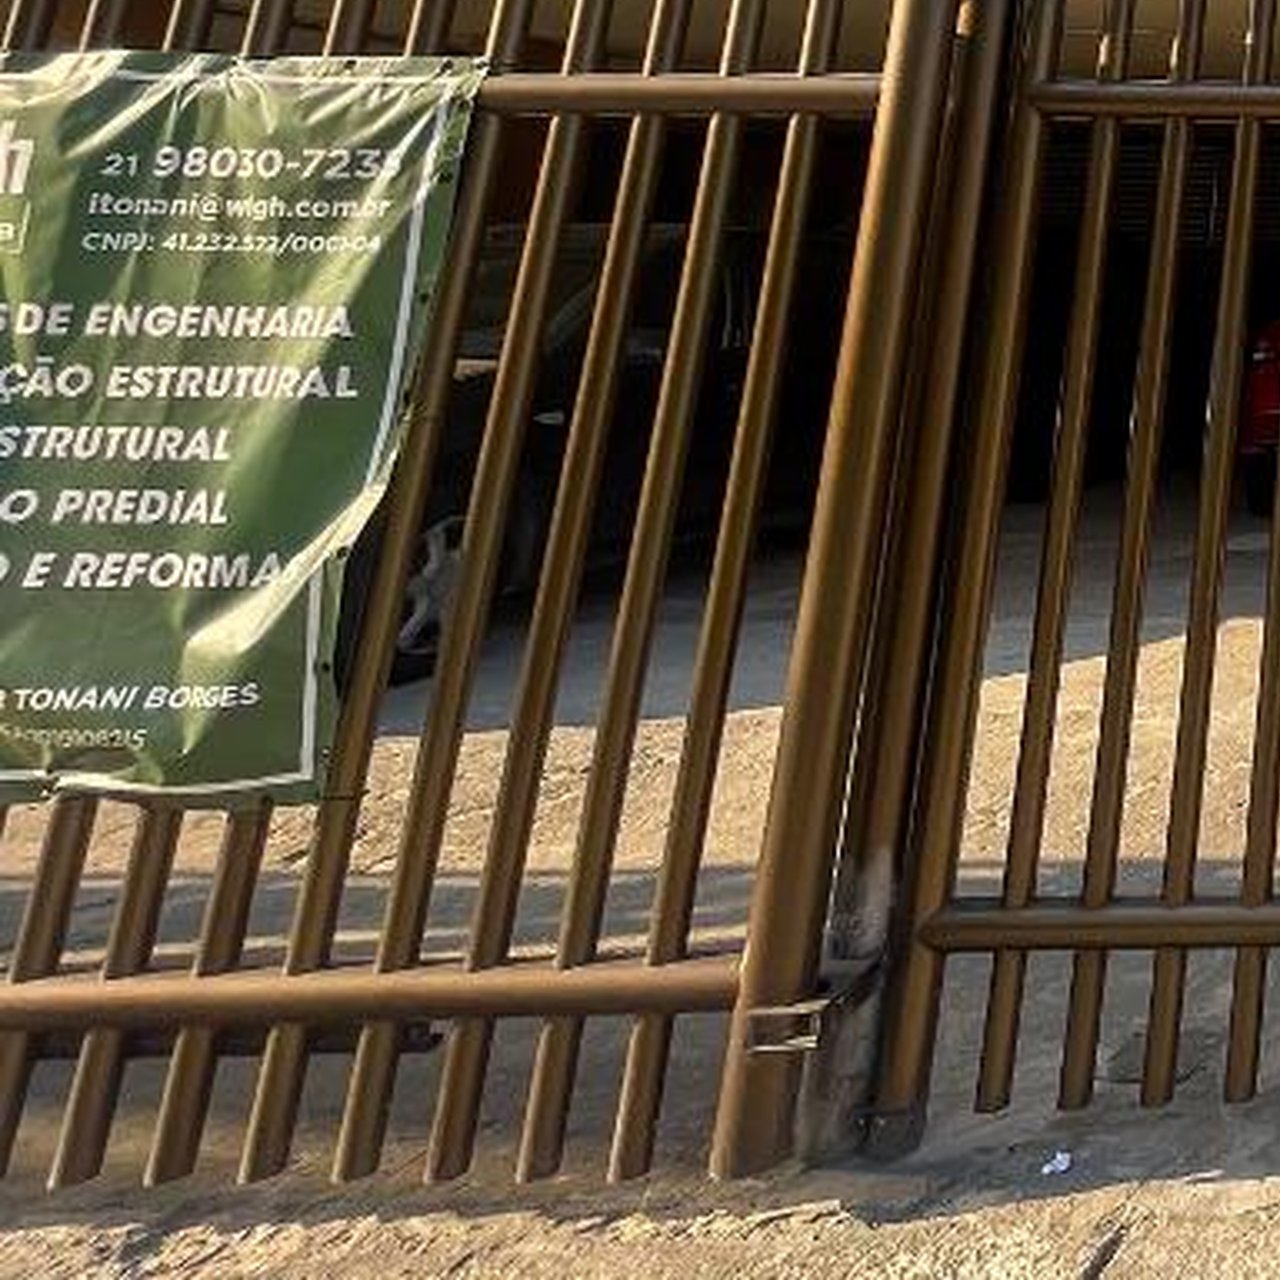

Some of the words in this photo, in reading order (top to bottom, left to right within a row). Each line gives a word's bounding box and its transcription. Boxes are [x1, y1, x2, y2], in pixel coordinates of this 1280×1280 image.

[102, 153, 138, 177] 21
[81, 231, 154, 253] CNPJ:
[15, 303, 74, 335] DE
[85, 305, 356, 338] ENGENHARIA
[105, 365, 359, 399] ESTRUTURAL
[51, 488, 229, 525] PREDIAL
[22, 552, 57, 588] E
[14, 686, 140, 712] TONANI
[143, 683, 261, 710] BORGES
